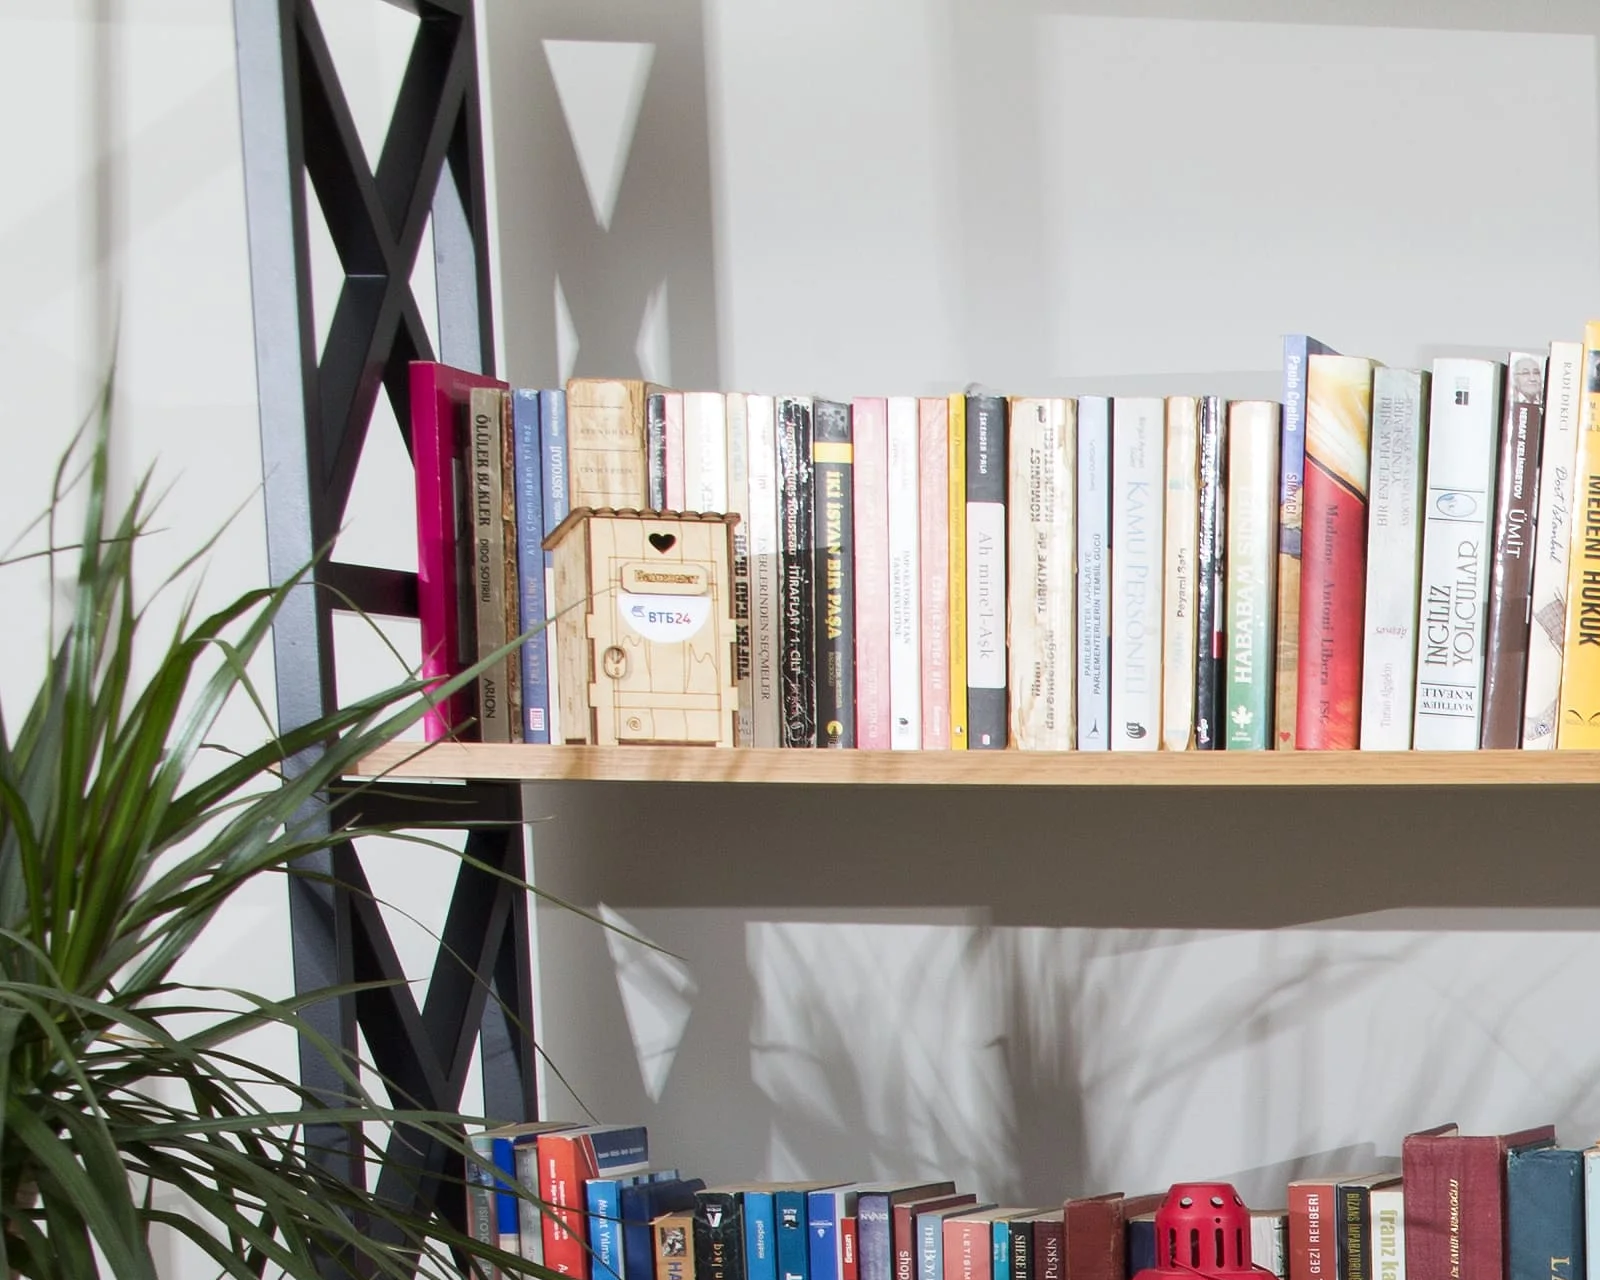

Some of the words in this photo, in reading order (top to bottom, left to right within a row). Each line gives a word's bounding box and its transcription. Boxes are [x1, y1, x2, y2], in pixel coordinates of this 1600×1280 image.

[1288, 355, 1301, 388] Paulo
[1286, 391, 1300, 431] Coelho
[826, 471, 842, 498] İKİ
[826, 502, 842, 553] İSYAN
[978, 532, 993, 556] Ah
[1506, 509, 1527, 558] ÜMİT
[1549, 504, 1568, 562] İstanbul
[828, 559, 843, 590] BİR
[825, 593, 842, 640] PAŞA
[1451, 541, 1478, 666] YOLCULAR
[1379, 1209, 1398, 1259] franz
